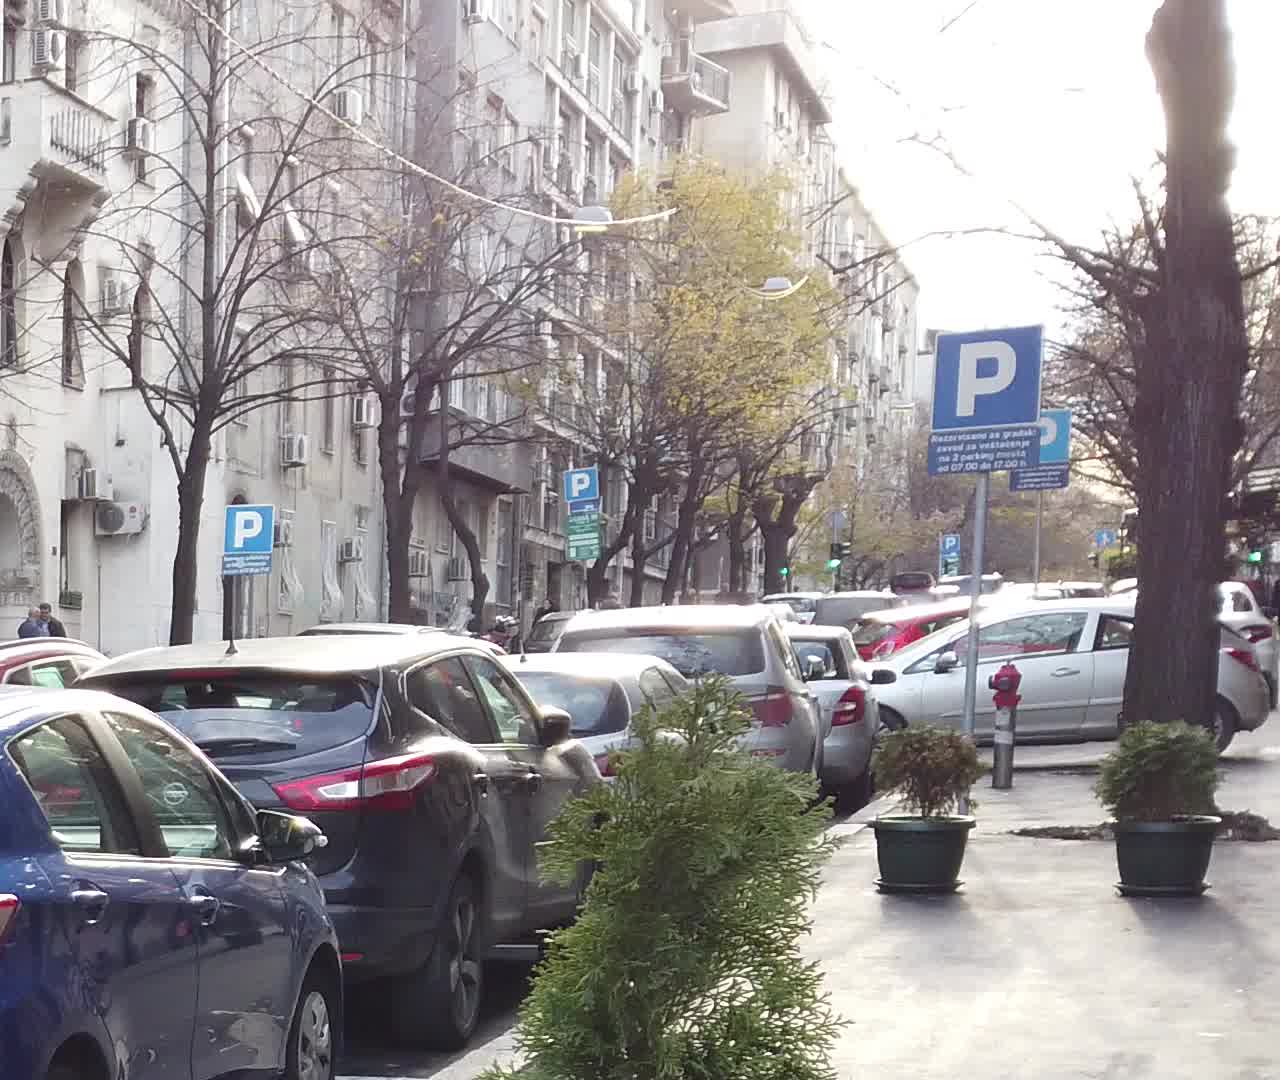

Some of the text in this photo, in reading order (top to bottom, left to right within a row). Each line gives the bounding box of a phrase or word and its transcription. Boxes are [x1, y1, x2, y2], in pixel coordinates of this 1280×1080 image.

[956, 340, 1017, 417] P
[571, 472, 591, 498] P
[233, 511, 263, 548] P
